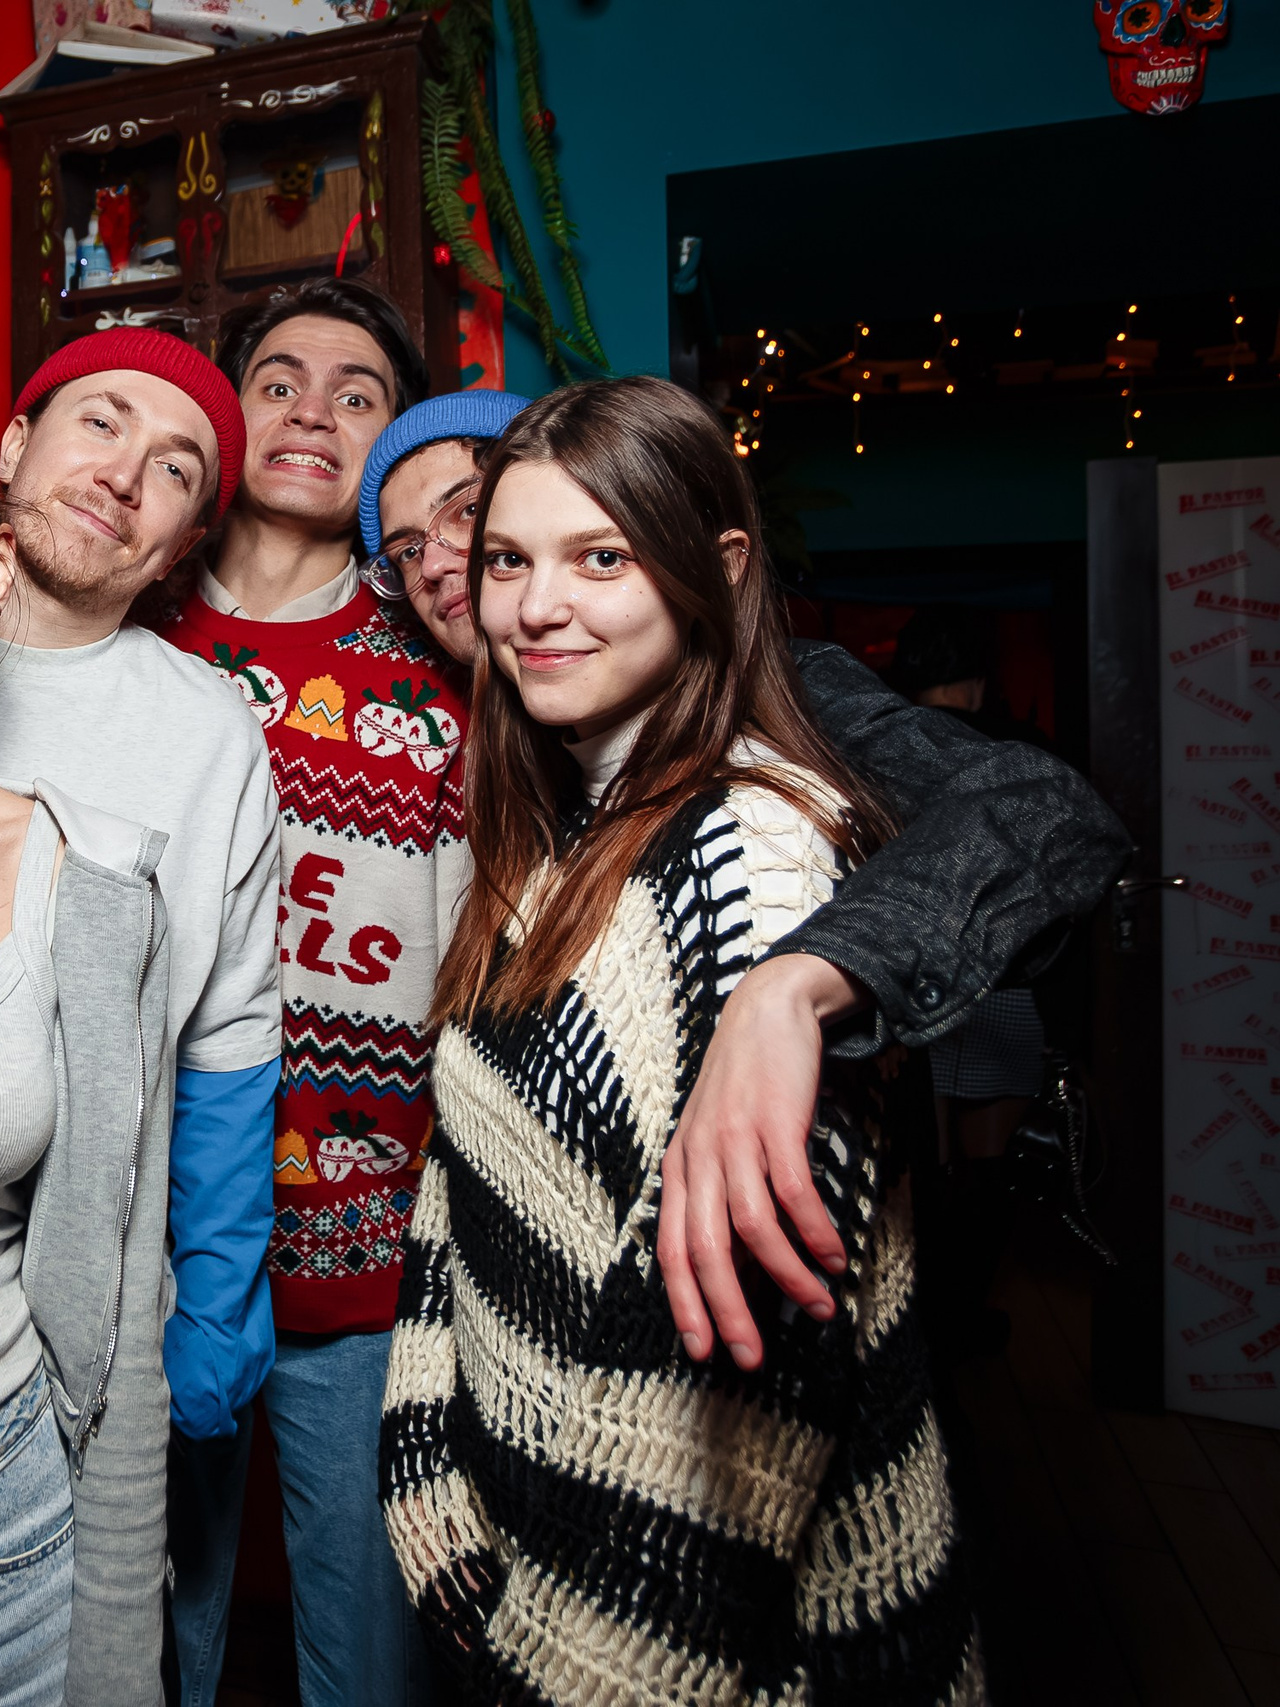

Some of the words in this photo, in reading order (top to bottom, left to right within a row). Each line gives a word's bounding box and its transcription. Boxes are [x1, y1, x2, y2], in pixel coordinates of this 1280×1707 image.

[1179, 495, 1195, 508] EL
[1202, 487, 1265, 504] PASTOR
[1165, 572, 1184, 588] EL
[1187, 550, 1249, 579] PASTOR
[1196, 590, 1213, 605] EL
[1218, 595, 1280, 616] PASTOR
[1169, 650, 1188, 665] EL
[1189, 626, 1247, 656] PASTOR
[1250, 649, 1269, 663] EL
[1253, 676, 1273, 692] EL
[1176, 676, 1193, 692] EL
[1196, 688, 1254, 725] PASTOR
[1185, 744, 1202, 757] EL
[1209, 745, 1272, 757] PASTOR
[1232, 777, 1252, 794] EL
[279, 851, 345, 914] E
[1250, 868, 1269, 884] EL
[1193, 882, 1254, 915] PASTOR
[275, 905, 403, 986] LS
[1192, 964, 1252, 994] PASTOR
[1181, 1043, 1198, 1056] EL
[1204, 1045, 1267, 1061] PASTOR
[1234, 1088, 1280, 1137] PASTOR
[1170, 1194, 1187, 1209] EL
[1192, 1202, 1257, 1229] PASTOR
[1173, 1251, 1192, 1269] EL
[1195, 1264, 1255, 1305] PASTOR
[1180, 1328, 1198, 1343] EL
